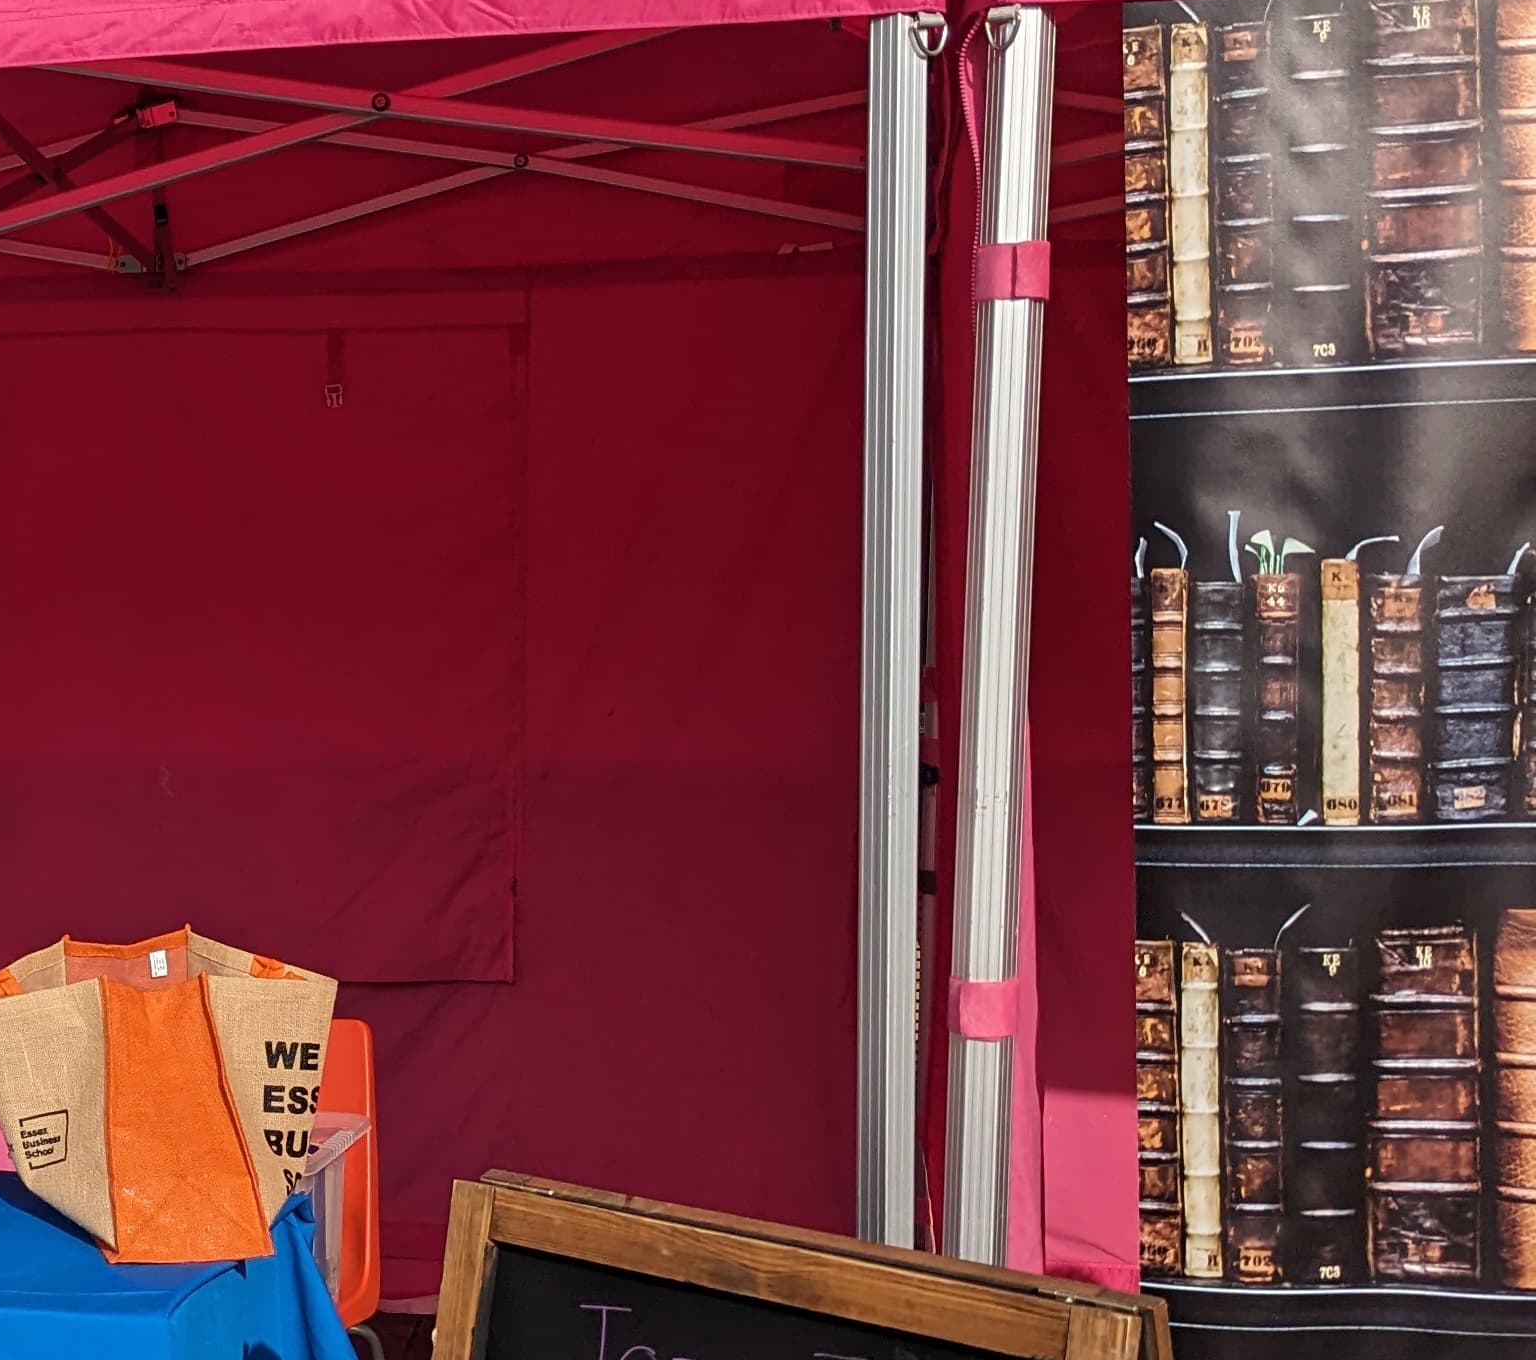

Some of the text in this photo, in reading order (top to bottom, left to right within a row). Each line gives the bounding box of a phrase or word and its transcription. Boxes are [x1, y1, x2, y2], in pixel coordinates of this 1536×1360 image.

[1313, 20, 1332, 33] KE
[1326, 798, 1358, 811] 680
[1322, 953, 1341, 966] KE
[264, 1041, 320, 1070] WE
[20, 1128, 48, 1139] Essex
[22, 1136, 61, 1149] Business
[25, 1146, 55, 1159] School
